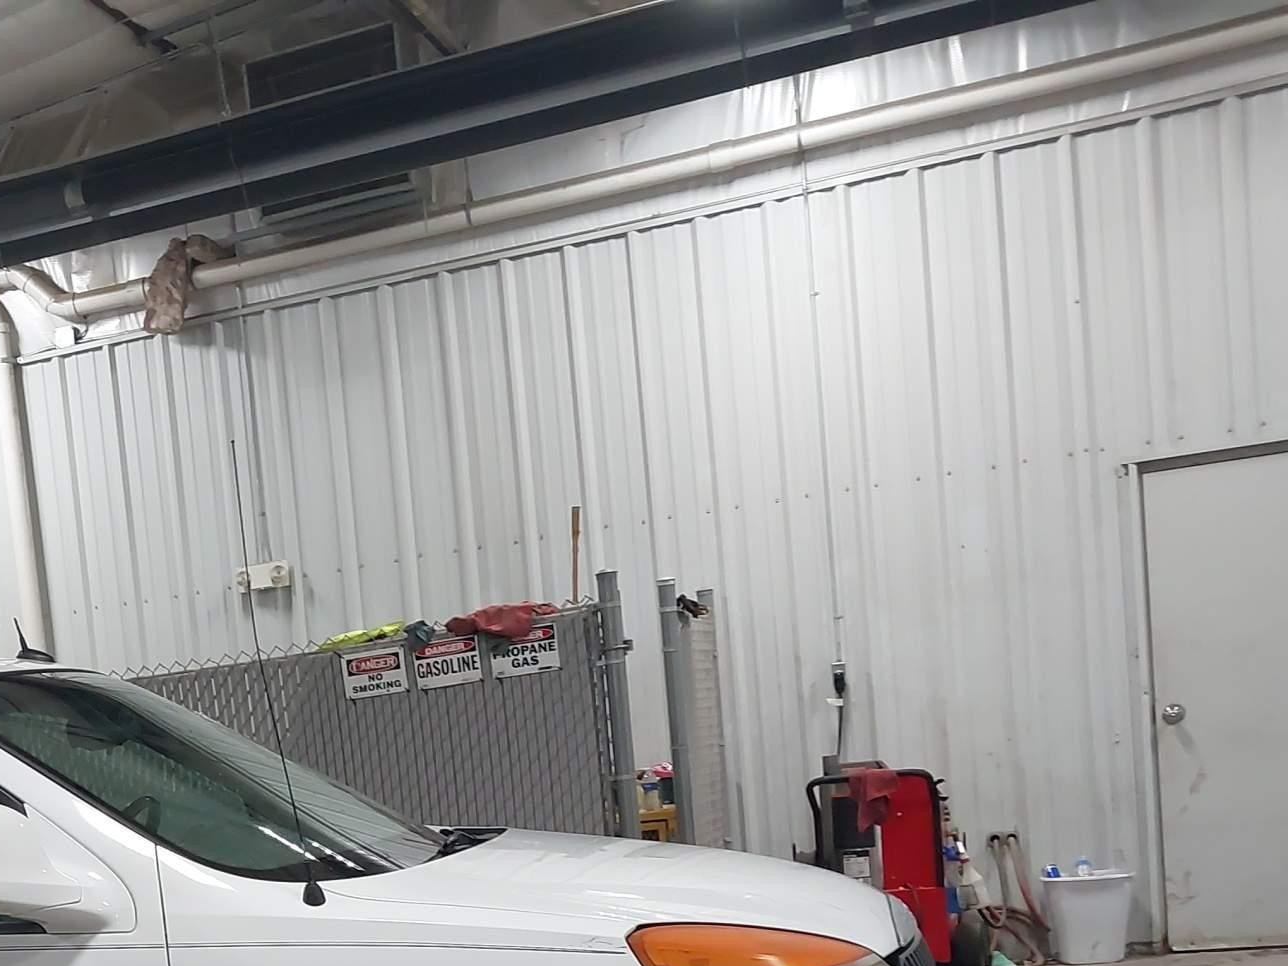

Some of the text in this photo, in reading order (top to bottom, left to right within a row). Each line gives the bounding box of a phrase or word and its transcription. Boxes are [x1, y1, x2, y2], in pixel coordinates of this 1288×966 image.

[424, 643, 464, 655] DANGER
[352, 657, 395, 672] DANGER
[417, 655, 480, 679] GASOLINE
[511, 656, 540, 669] GAS
[368, 673, 384, 683] NO
[352, 680, 402, 694] SMOKING
